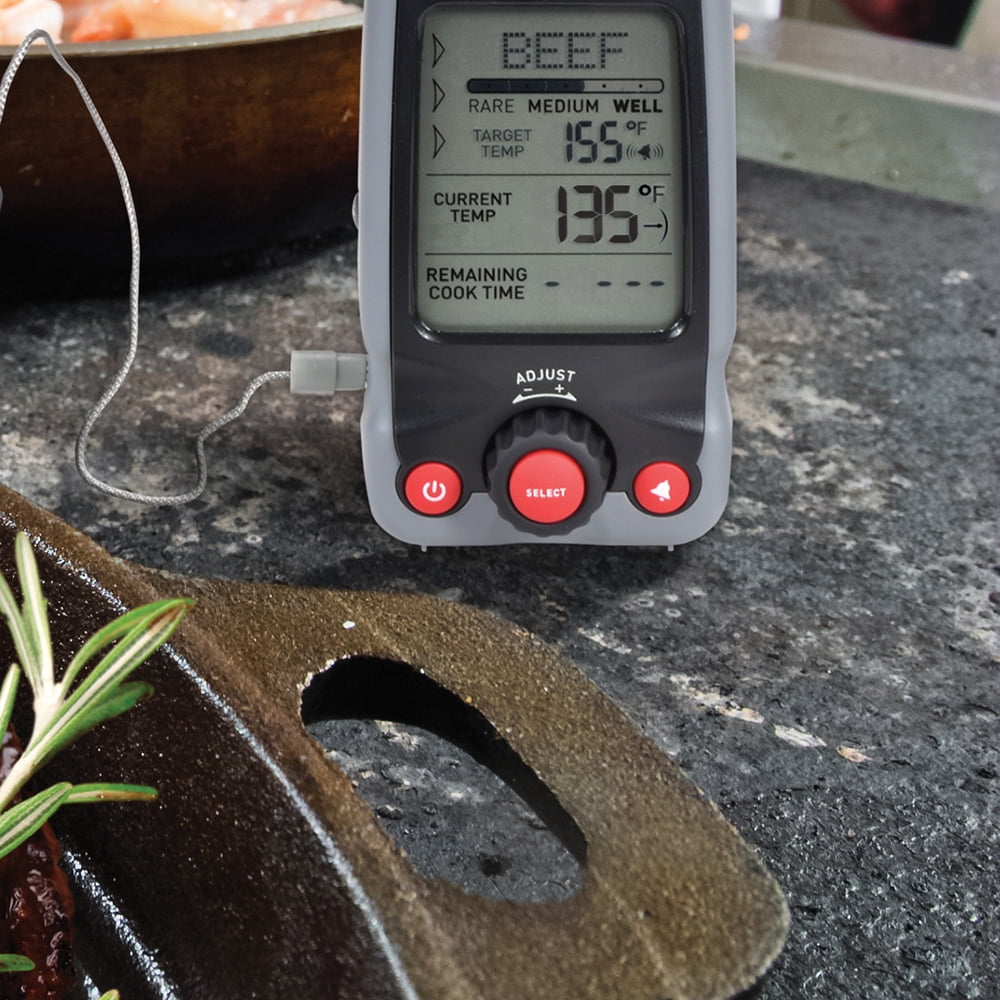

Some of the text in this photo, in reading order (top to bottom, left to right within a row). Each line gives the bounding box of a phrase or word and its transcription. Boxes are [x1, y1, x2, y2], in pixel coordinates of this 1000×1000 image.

[502, 32, 629, 69] BEEF
[468, 98, 663, 114] RARE MEDIUM WELL
[472, 129, 532, 143] TARGET
[565, 121, 623, 164] 155
[481, 144, 525, 158] TEMP
[433, 192, 513, 206] CURRENT
[450, 208, 496, 223] TEMP
[556, 184, 639, 244] 135
[426, 267, 528, 282] REMAINING
[428, 285, 525, 300] COOK TIME
[516, 369, 576, 385] ADJUST
[525, 487, 567, 498] SELECT
